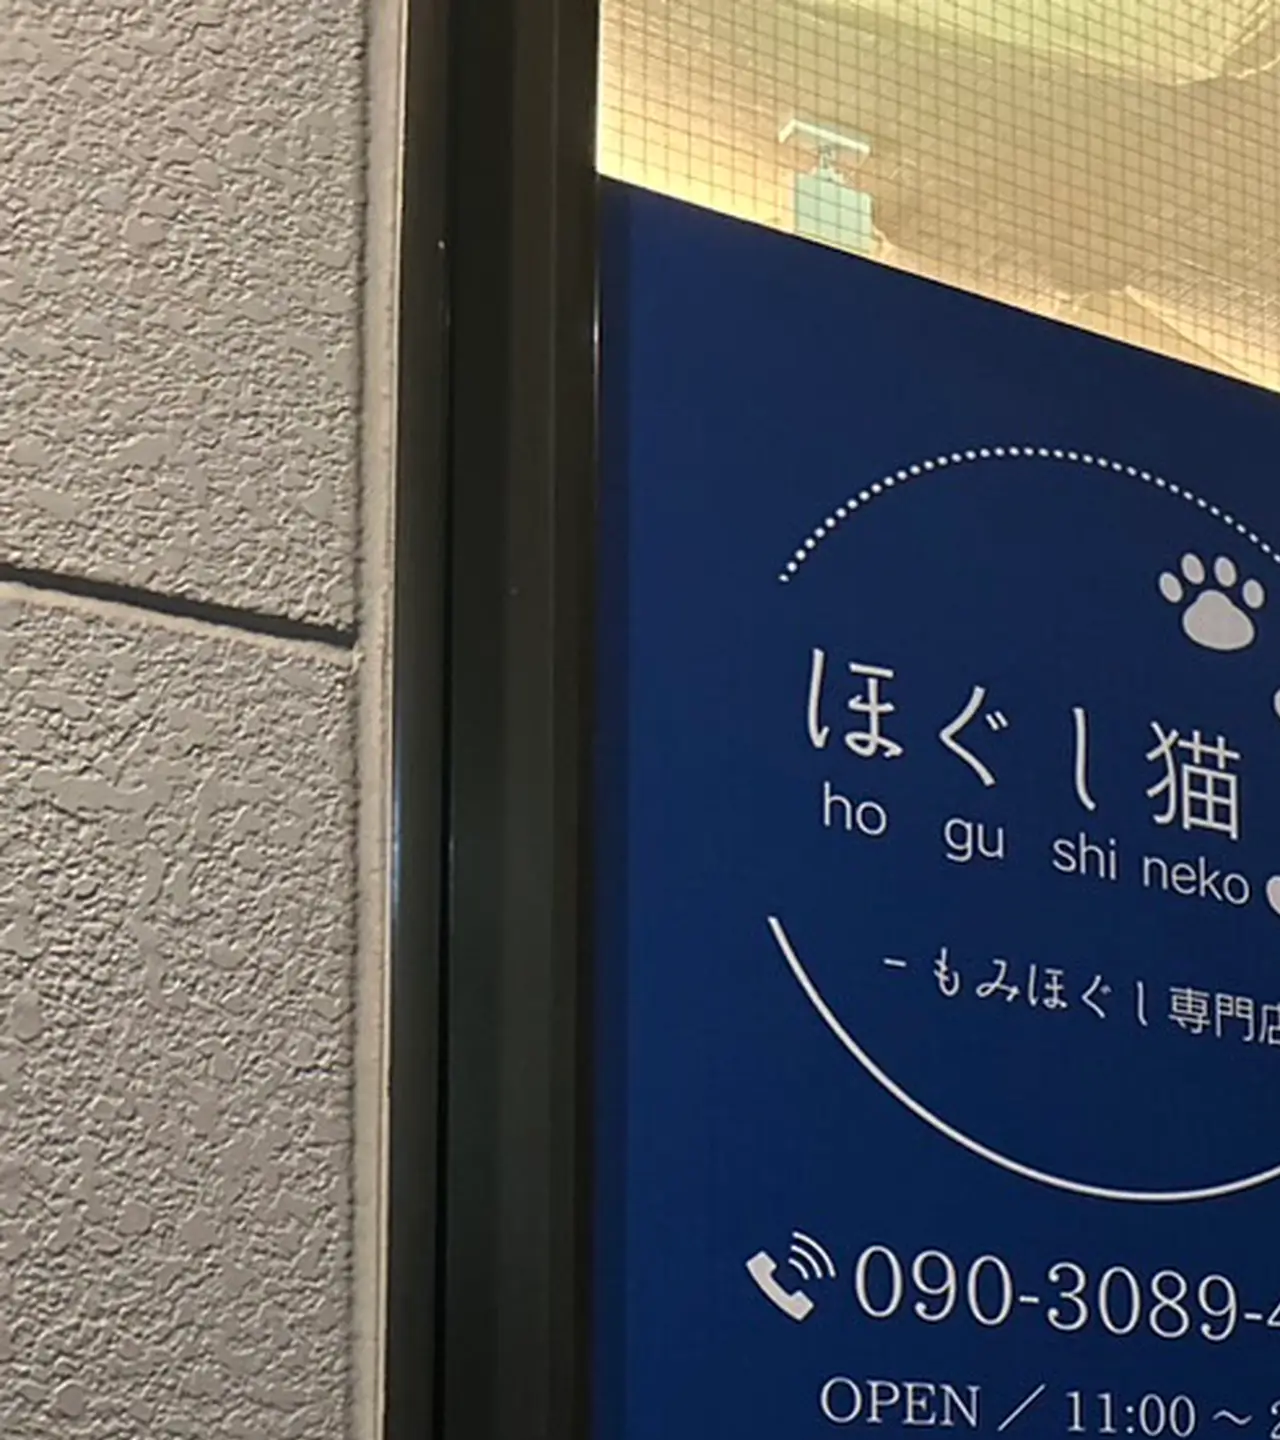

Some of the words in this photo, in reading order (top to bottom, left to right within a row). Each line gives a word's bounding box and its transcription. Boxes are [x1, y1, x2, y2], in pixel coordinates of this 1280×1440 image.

[808, 648, 1241, 840] ほぐし猫
[824, 781, 888, 836] ho
[944, 817, 1004, 863] gu
[1052, 832, 1117, 881] shi
[1142, 855, 1251, 905] neko
[819, 1376, 980, 1428] OPEN
[1066, 1390, 1197, 1438] 11:00
